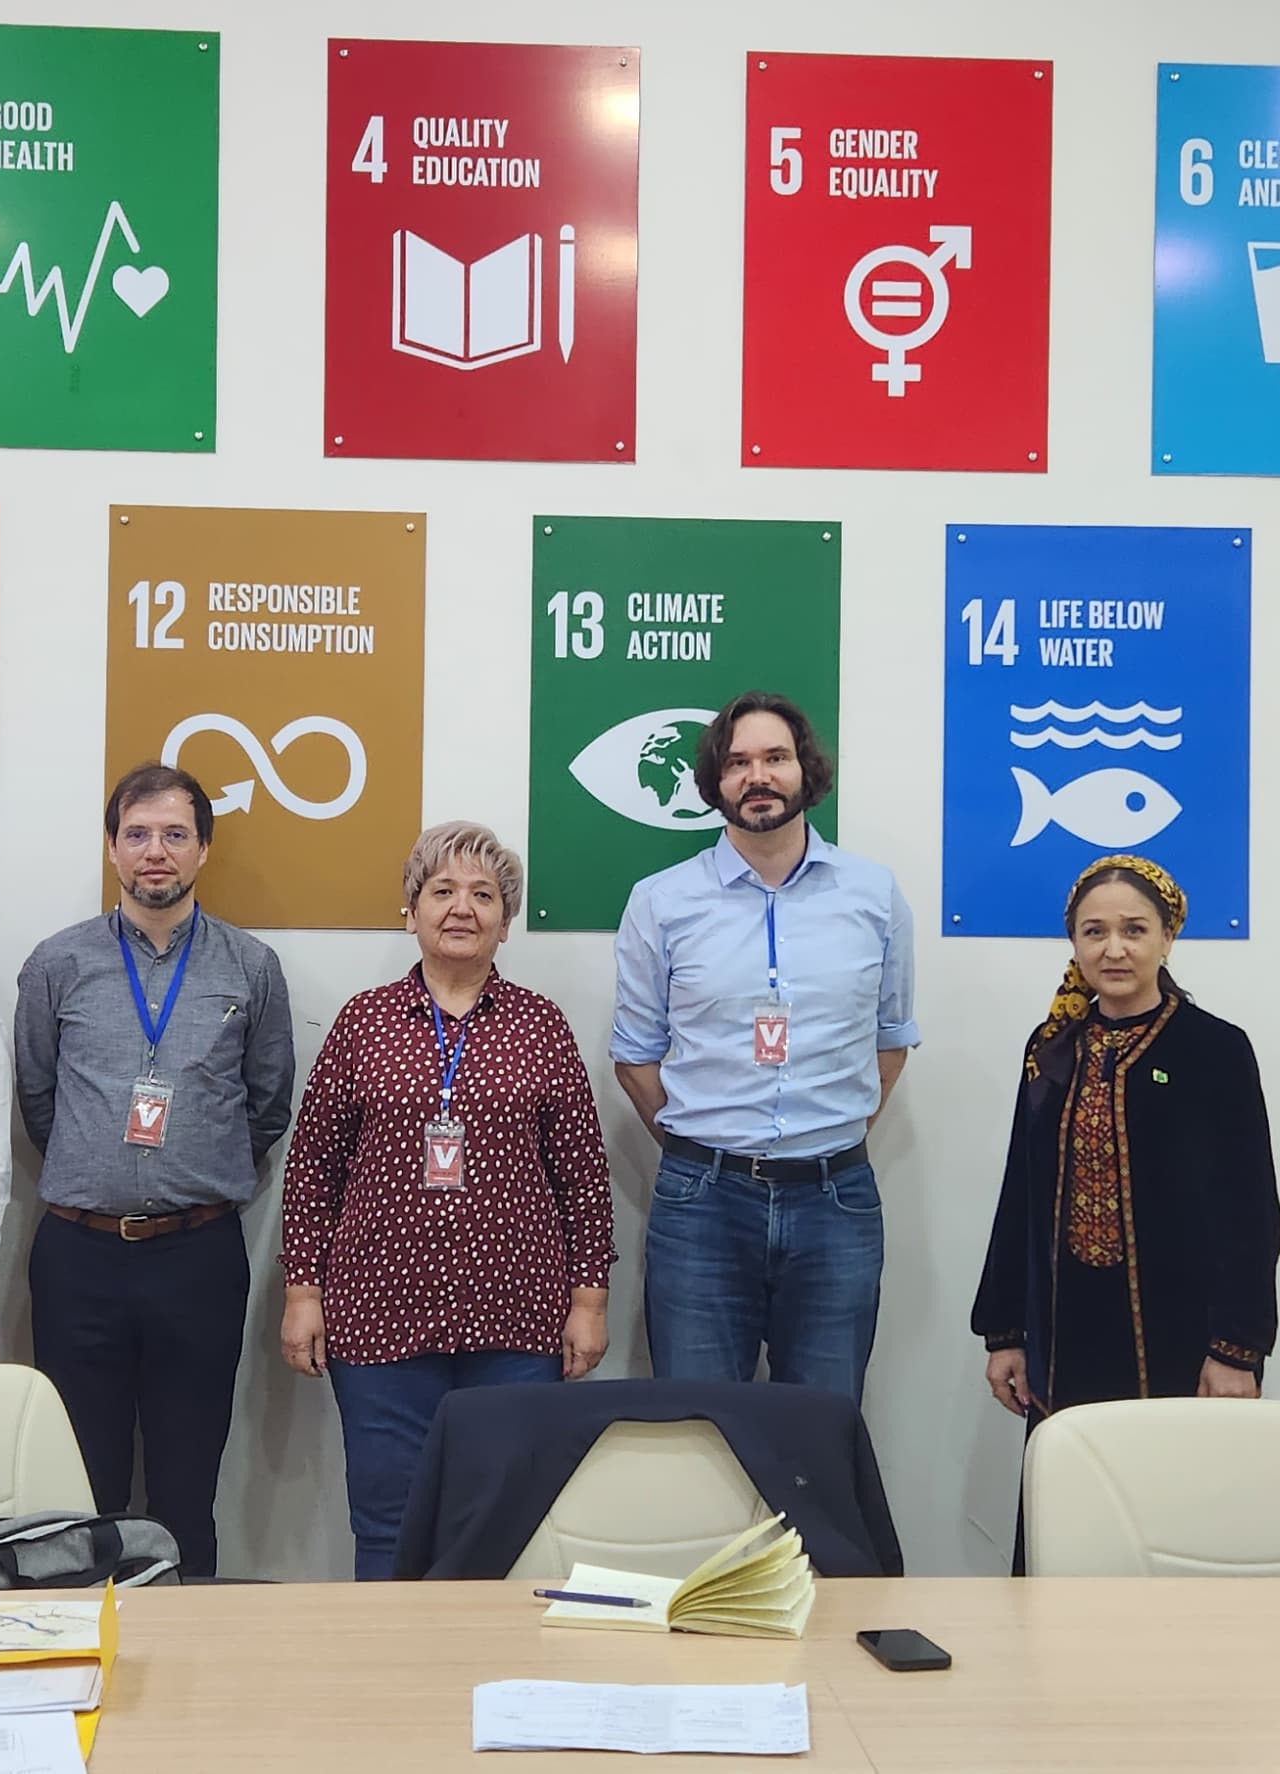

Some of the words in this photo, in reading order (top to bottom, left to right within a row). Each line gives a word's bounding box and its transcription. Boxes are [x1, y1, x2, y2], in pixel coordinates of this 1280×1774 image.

[414, 117, 508, 149] QUALITY
[830, 129, 917, 159] GENDER
[352, 116, 387, 183] 4
[771, 127, 802, 195] 5
[413, 156, 539, 187] EDUCATION
[830, 167, 938, 199] EQUALITY
[1180, 139, 1213, 205] 6
[209, 583, 360, 614] RESPONSIBLE
[628, 593, 724, 623] CLIMATE
[129, 581, 185, 648] 12
[548, 592, 603, 659] 13
[1040, 600, 1083, 628] LIFE
[1089, 601, 1164, 629] BELOW
[208, 622, 374, 654] CONSUMPTION
[627, 631, 711, 660] ACTION
[962, 599, 1019, 665] 14
[1040, 638, 1113, 666] WATER
[759, 1023, 784, 1047] V
[432, 1144, 458, 1169] V
